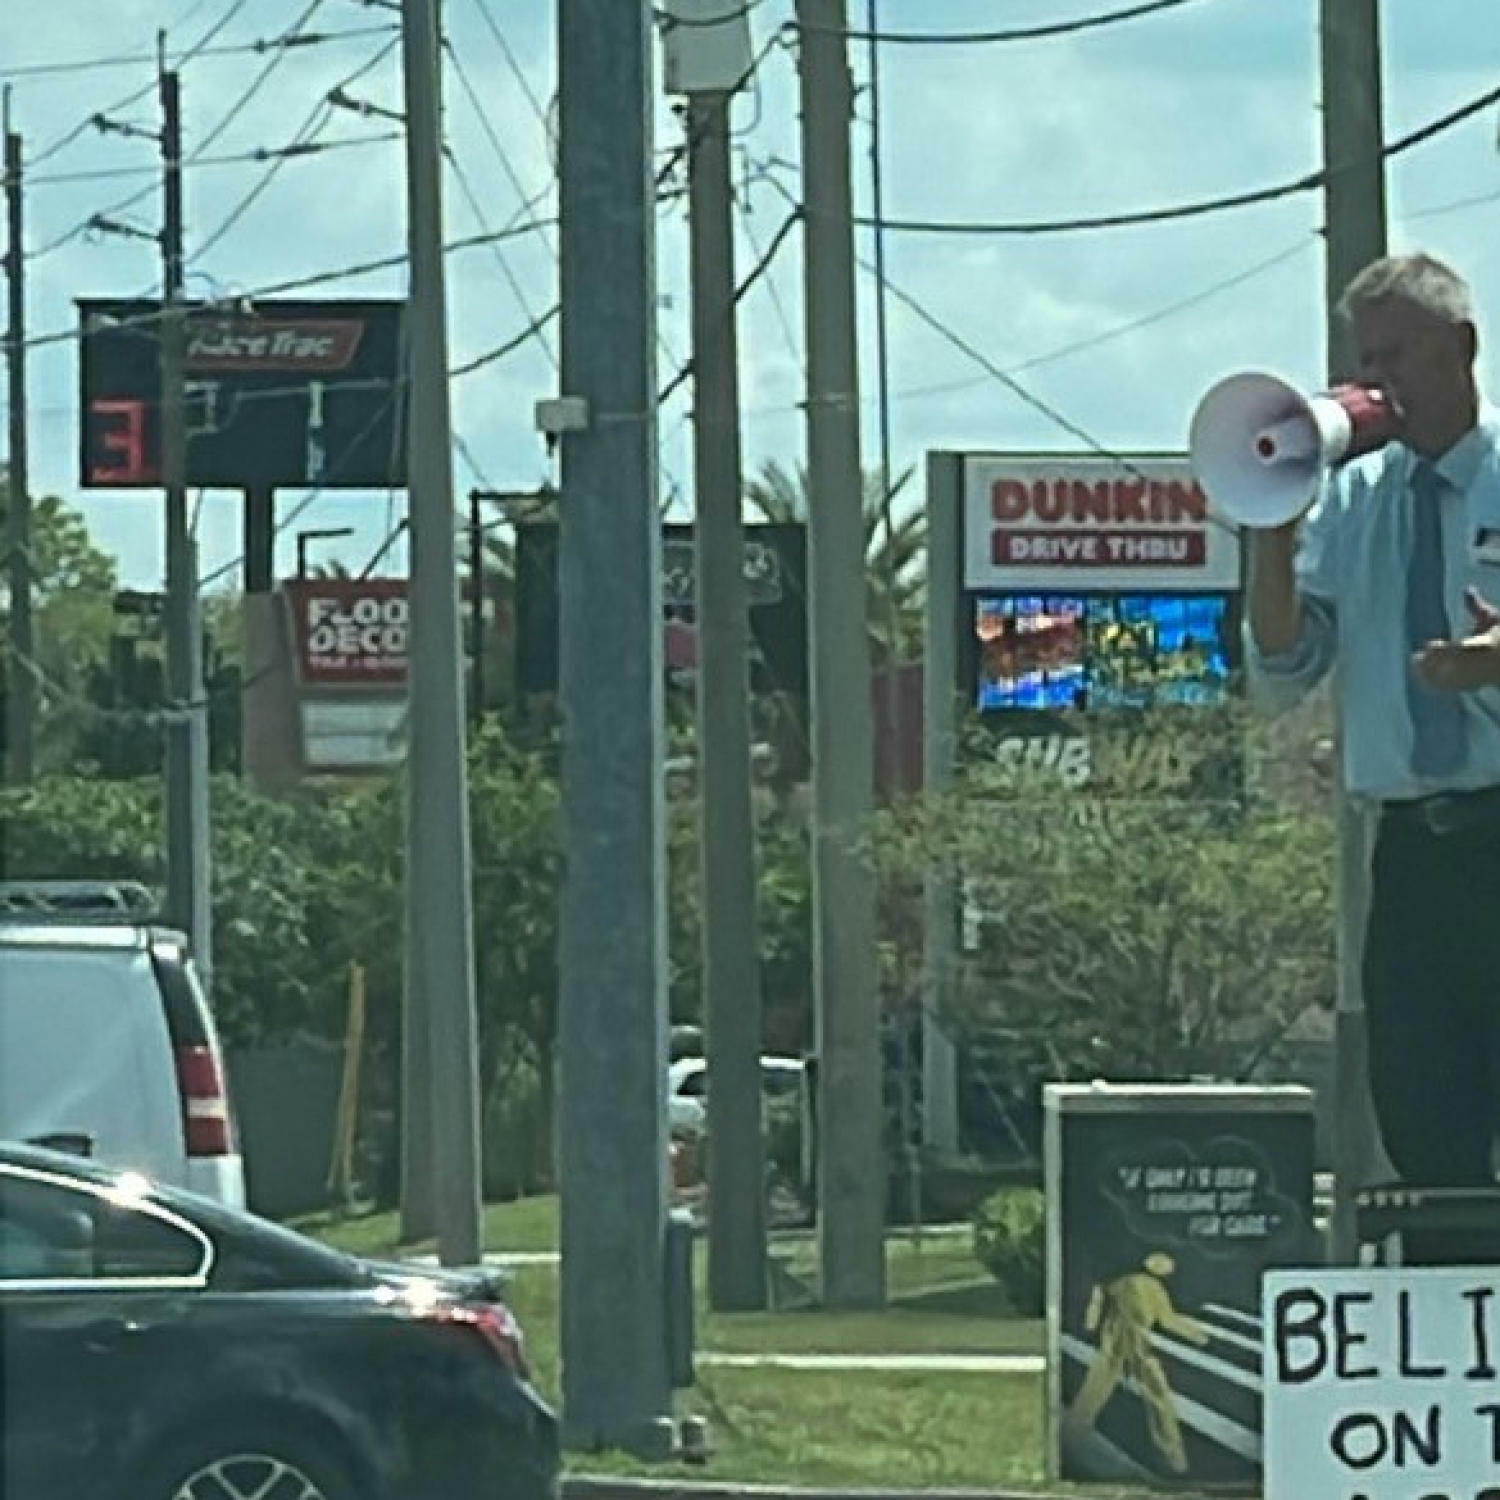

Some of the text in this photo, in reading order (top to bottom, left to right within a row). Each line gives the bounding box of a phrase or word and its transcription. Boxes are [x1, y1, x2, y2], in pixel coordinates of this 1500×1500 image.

[1009, 537, 1189, 560] DRIVE THRU
[308, 597, 409, 627] FLOO
[309, 624, 407, 654] DECO
[1330, 1404, 1440, 1468] ON
